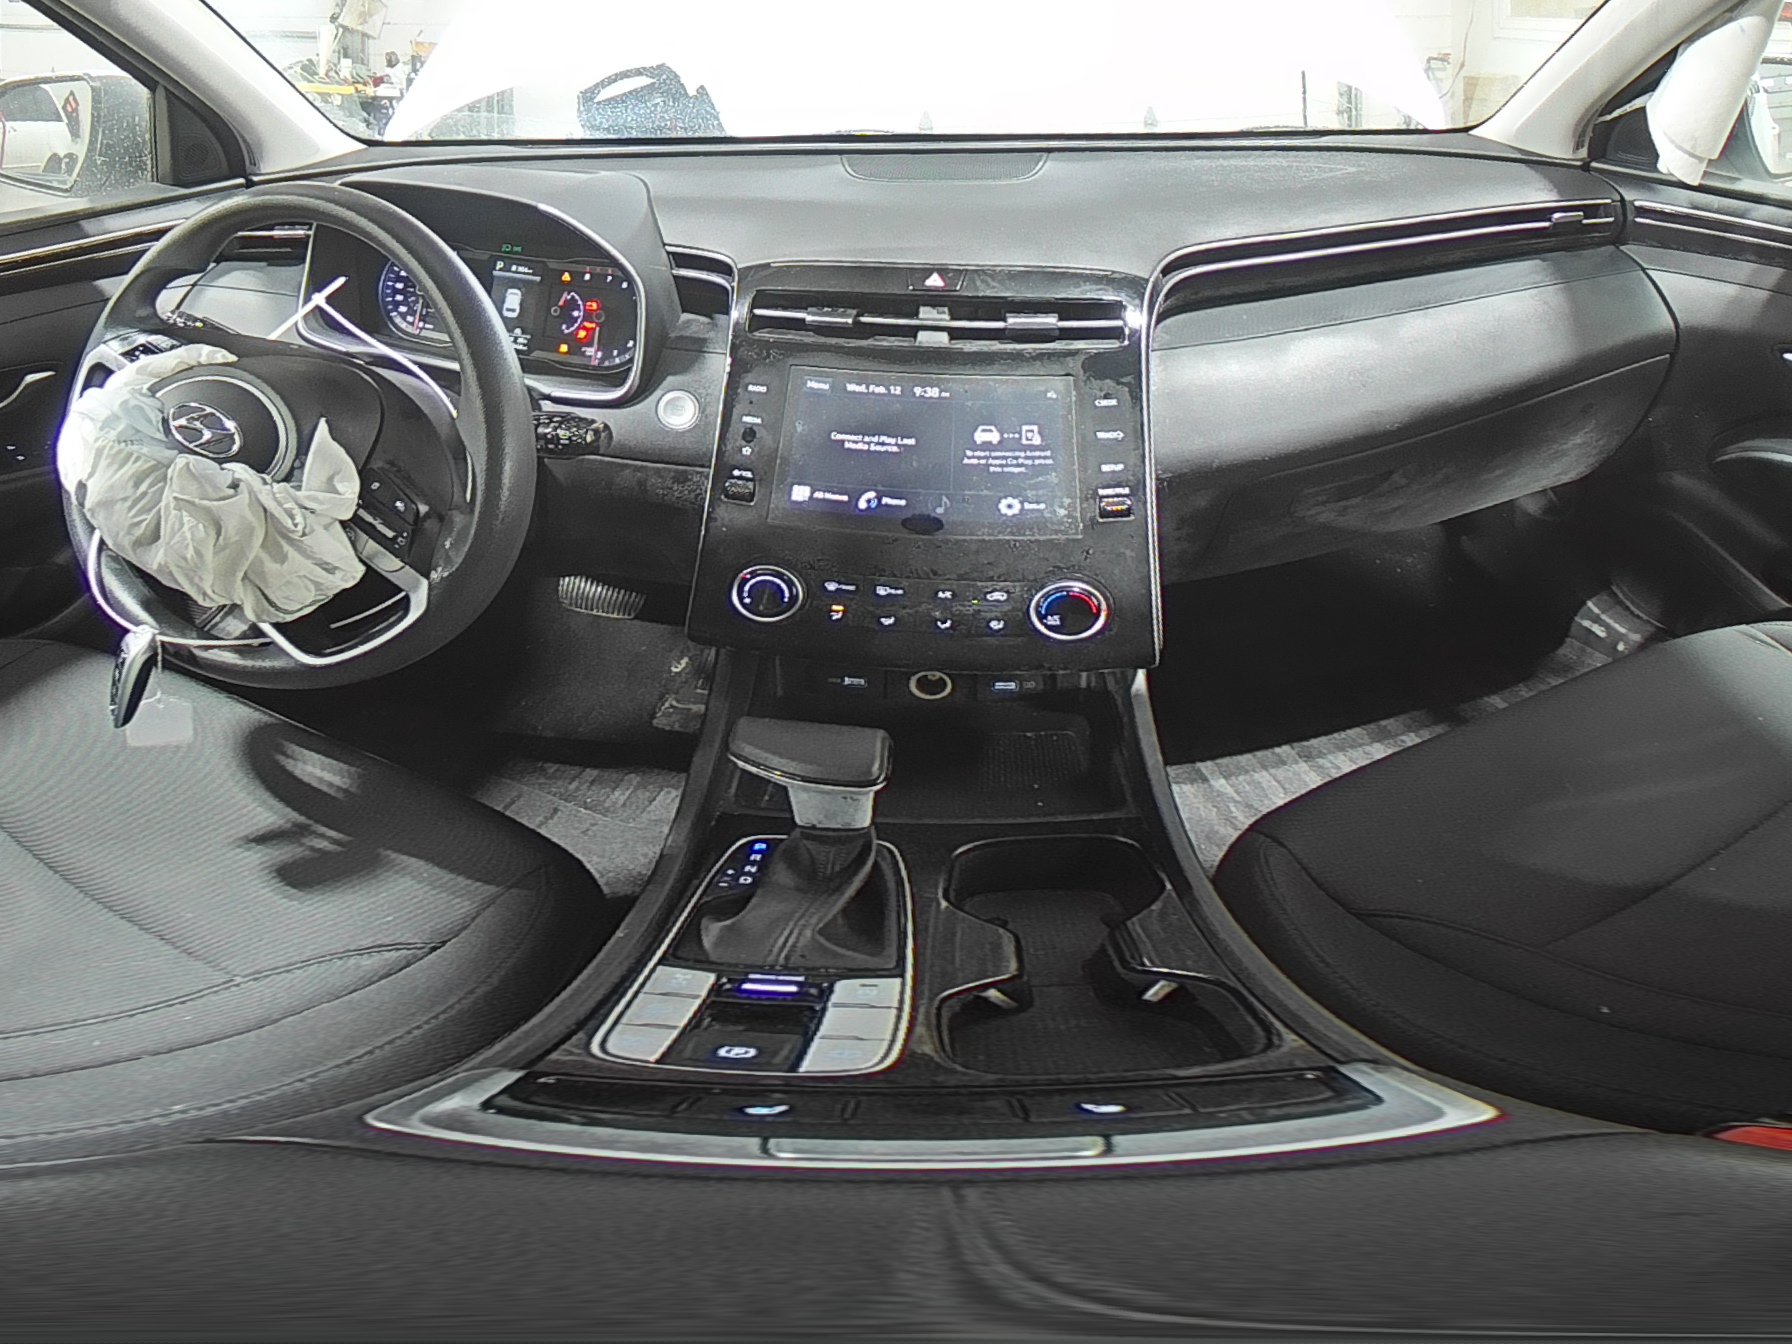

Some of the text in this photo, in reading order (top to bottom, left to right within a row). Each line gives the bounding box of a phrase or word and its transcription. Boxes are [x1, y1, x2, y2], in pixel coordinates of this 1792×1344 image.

[496, 261, 504, 270] P
[890, 386, 901, 395] 12
[913, 386, 940, 398] 9:38
[830, 432, 862, 441] Connect
[863, 435, 878, 443] and
[879, 436, 896, 445] Play
[744, 865, 757, 873] N
[739, 876, 753, 884] D
